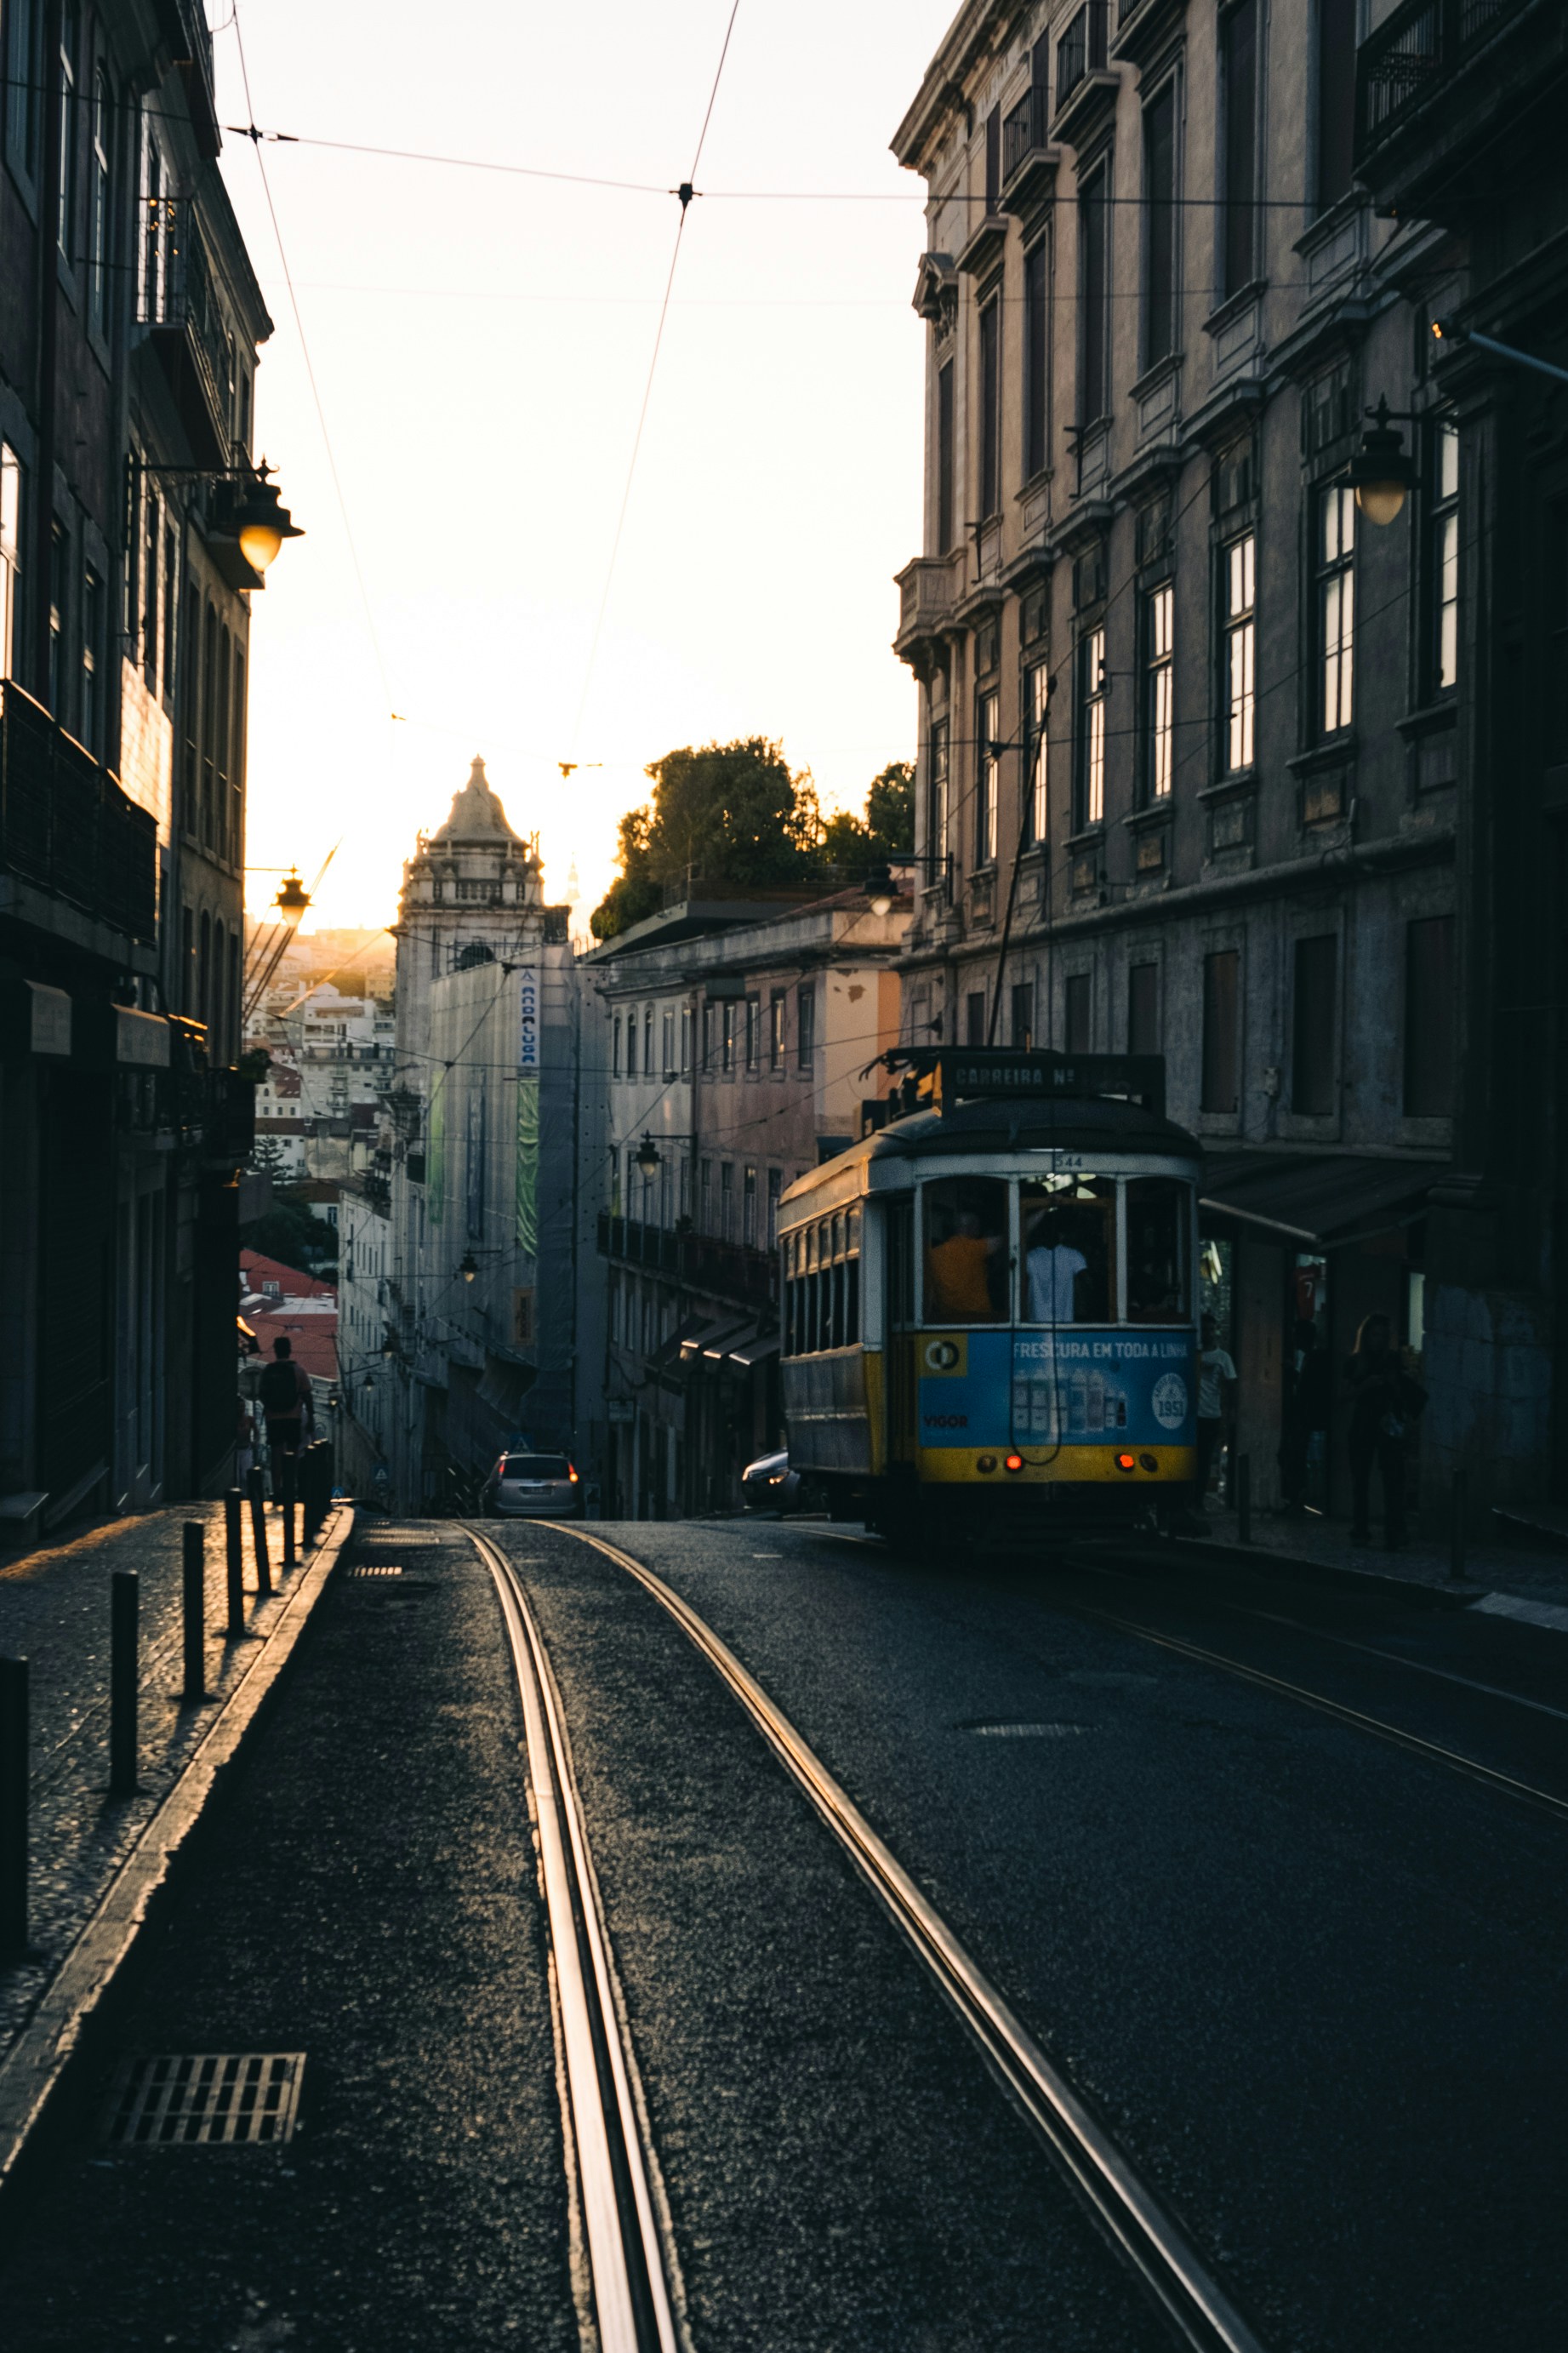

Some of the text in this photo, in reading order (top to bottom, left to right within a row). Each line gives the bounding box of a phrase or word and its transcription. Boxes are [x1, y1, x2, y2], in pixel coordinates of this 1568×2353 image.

[955, 1068, 1043, 1086] CARREIRA
[1303, 1281, 1314, 1299] 7
[1092, 1342, 1112, 1359] EM
[1115, 1342, 1149, 1359] TODA
[1151, 1343, 1159, 1358] A
[1159, 1400, 1184, 1417] 1951
[923, 1415, 968, 1427] VIGOR
